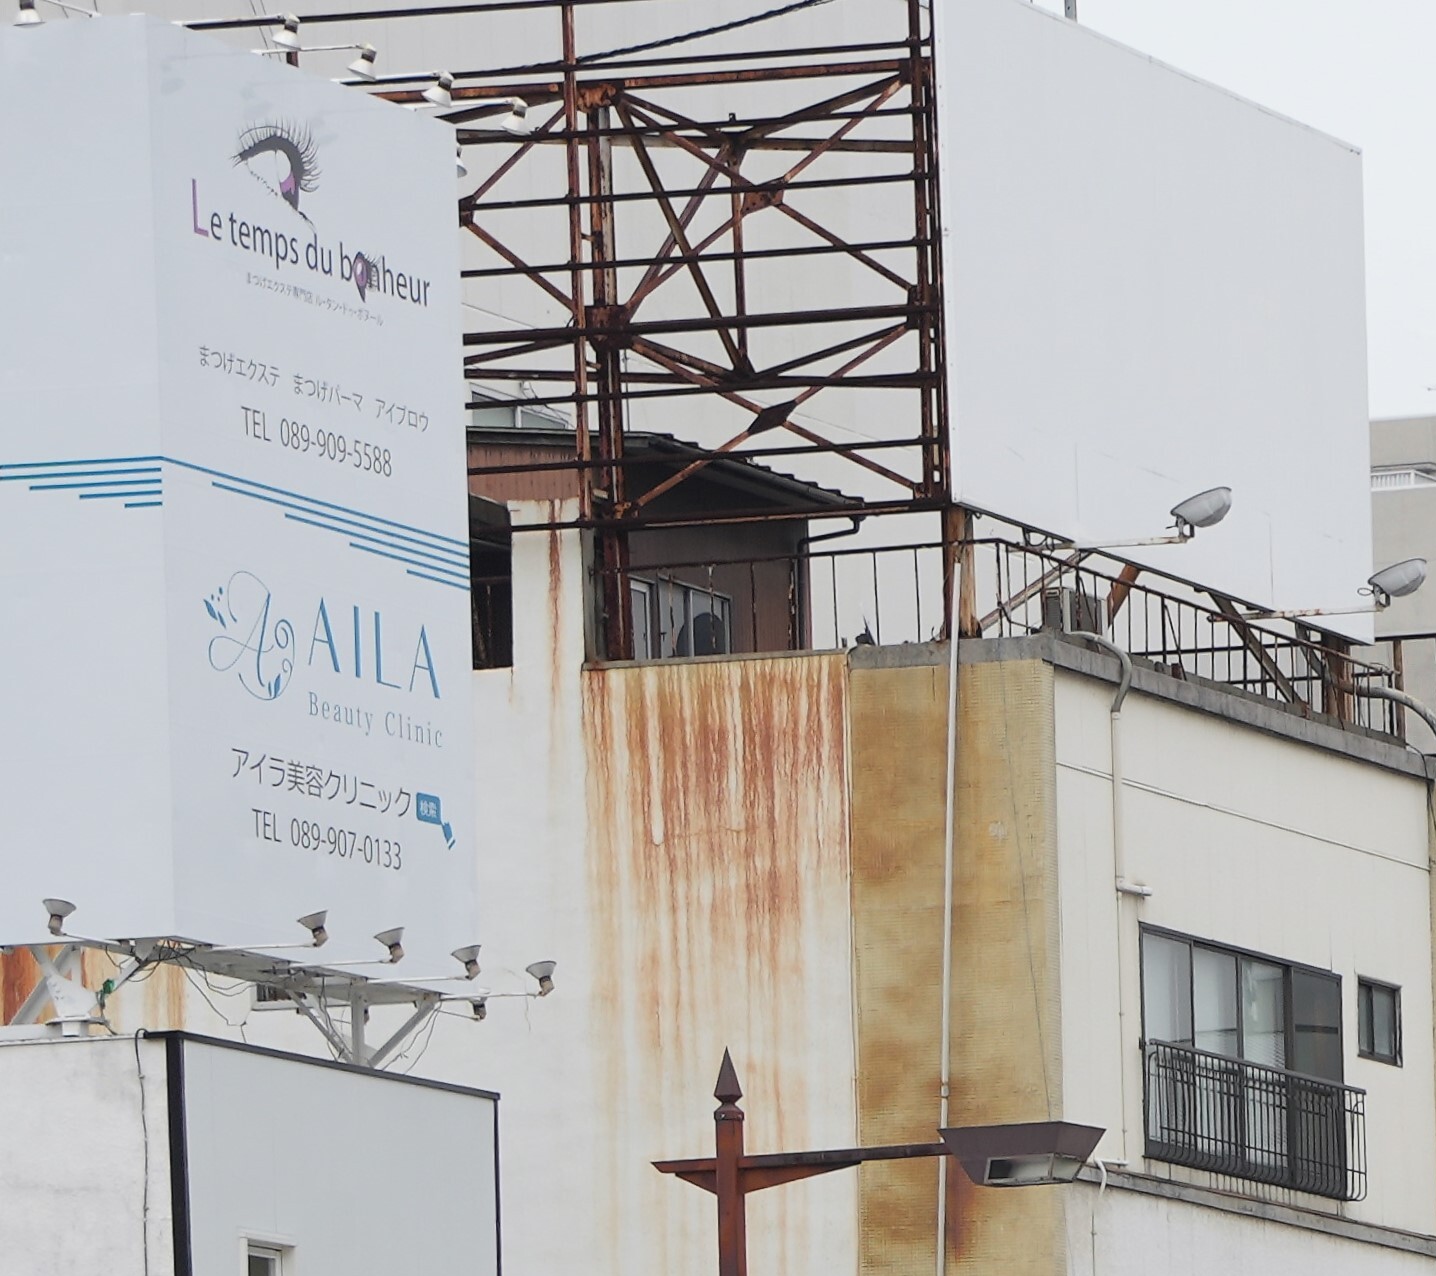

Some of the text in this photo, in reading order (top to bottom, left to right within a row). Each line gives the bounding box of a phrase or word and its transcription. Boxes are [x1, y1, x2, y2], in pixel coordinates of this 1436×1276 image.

[192, 178, 431, 307] Le temps du bonheur
[199, 345, 430, 433] まつげエクステ まつげパーマ アイブロウ
[241, 405, 392, 477] TEL 089-909-5588
[308, 597, 440, 699] AILA
[308, 691, 443, 748] Beauty Clinic
[231, 747, 412, 818] アイラ美容クリニック
[252, 808, 401, 870] TEL 089-907-0133
